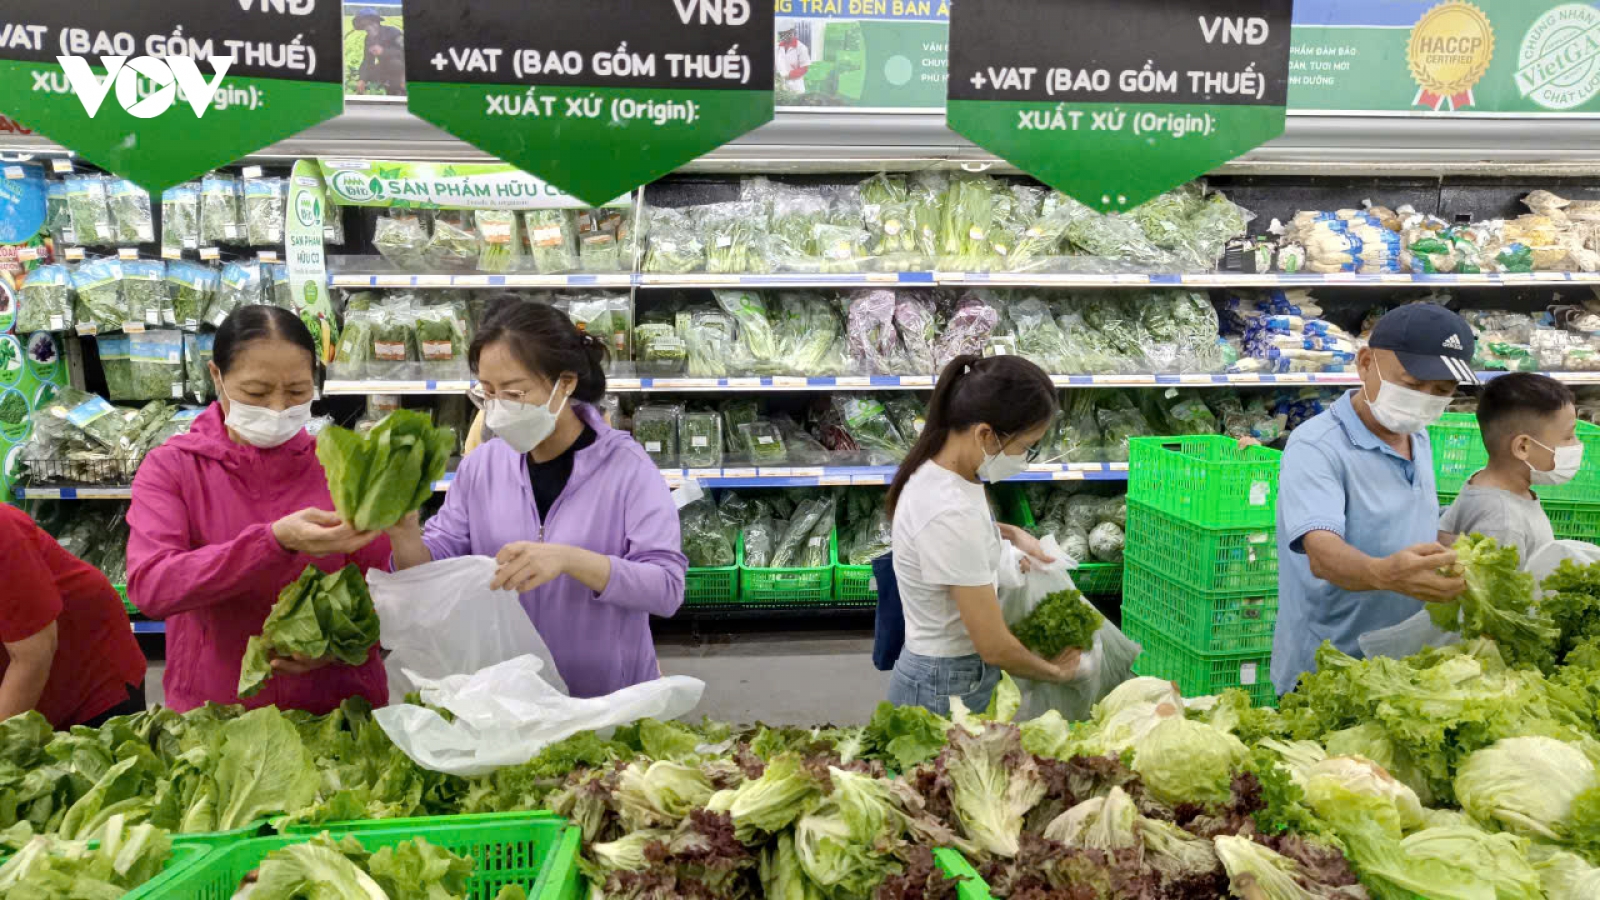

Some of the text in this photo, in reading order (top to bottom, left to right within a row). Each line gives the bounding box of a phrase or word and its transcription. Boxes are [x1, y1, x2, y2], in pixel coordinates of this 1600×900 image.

[673, 0, 751, 26] VNĐ
[1199, 16, 1269, 45] VNĐ
[1420, 36, 1481, 54] HACCP
[60, 27, 135, 56] (BAO
[223, 33, 316, 75] THUẾ)
[430, 41, 751, 84] +VAT (BAO GỒM THUẾ)
[1426, 54, 1473, 65] CERTIFIED
[970, 60, 1266, 99] +VAT (BAO GỒM THUẾ)
[486, 87, 700, 126] XUẤT XỨ (Origin):
[1017, 102, 1216, 138] XUẤT XỨ (Origin):
[434, 177, 491, 197] PHẨM
[496, 180, 538, 197] HỮU
[545, 183, 568, 196] C
